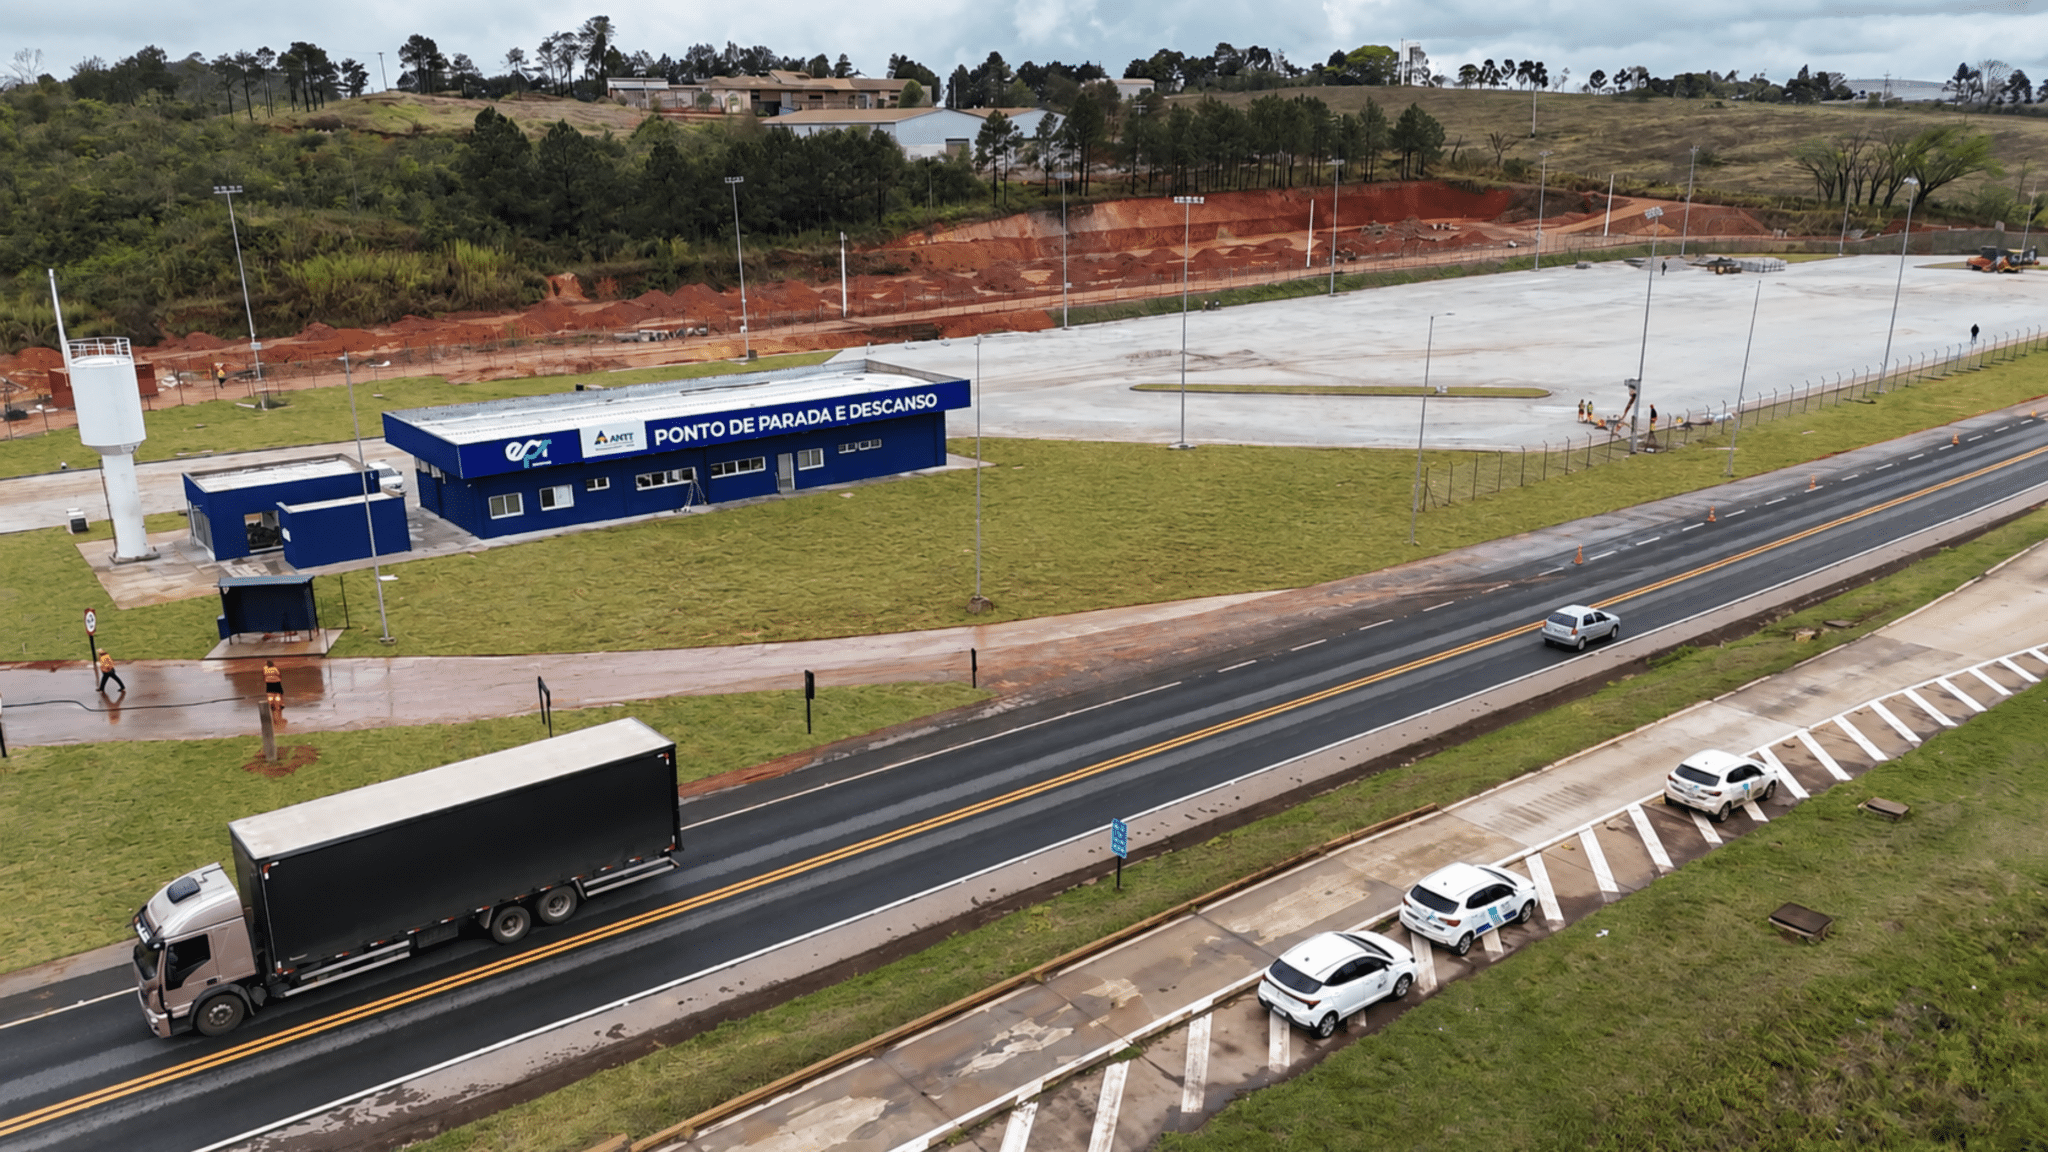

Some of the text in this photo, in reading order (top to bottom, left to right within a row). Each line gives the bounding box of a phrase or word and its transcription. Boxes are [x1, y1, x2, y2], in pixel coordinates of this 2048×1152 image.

[654, 393, 938, 446] PONTO DE PARADA E DESCANSO
[610, 432, 634, 442] ANTT
